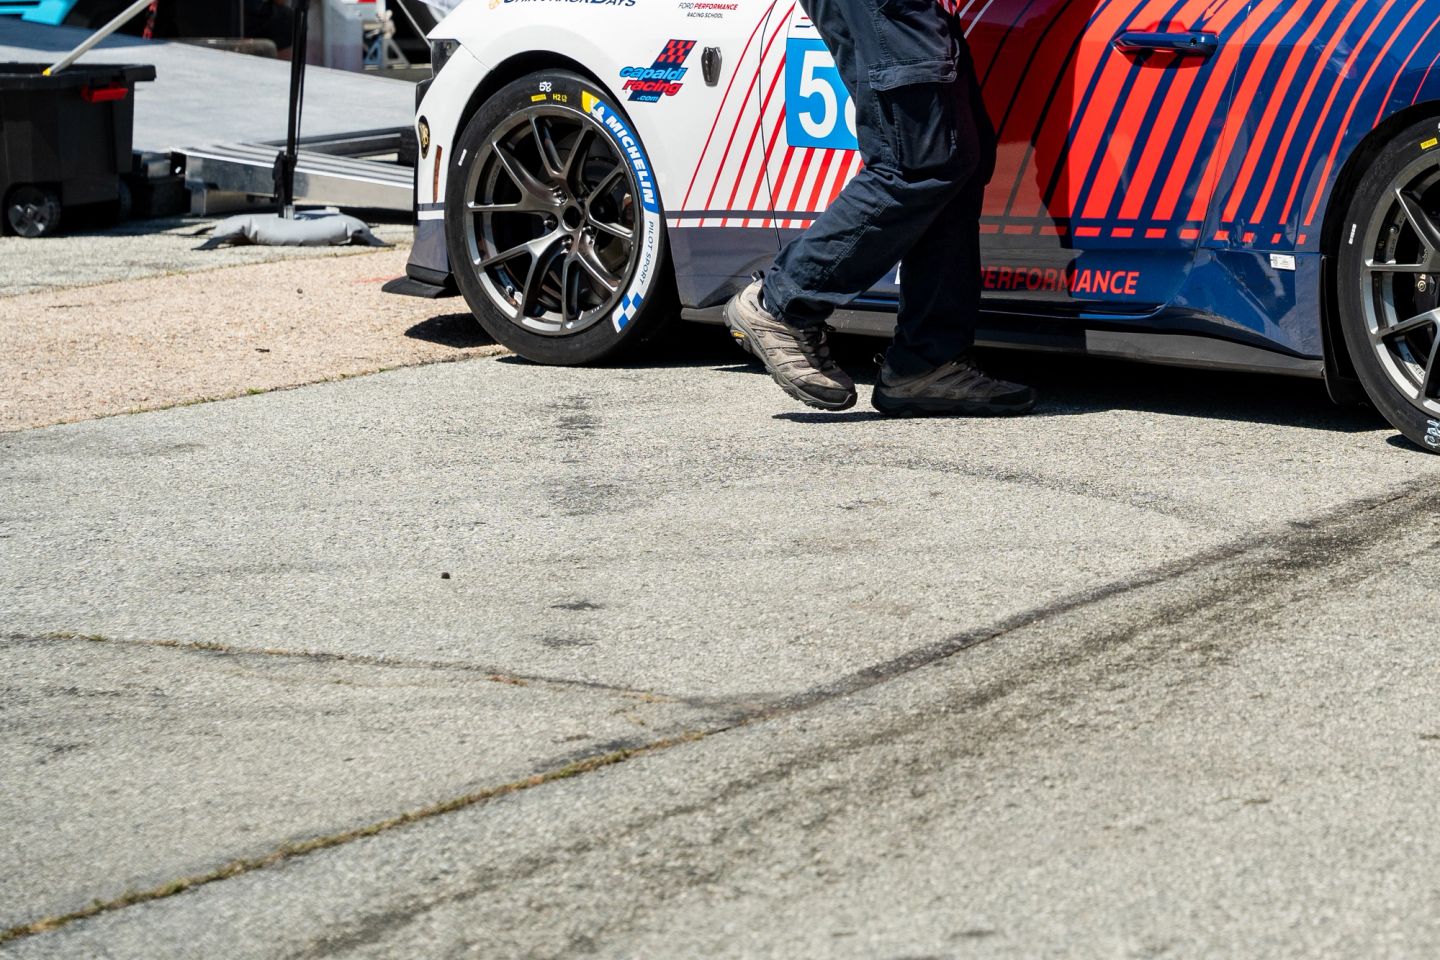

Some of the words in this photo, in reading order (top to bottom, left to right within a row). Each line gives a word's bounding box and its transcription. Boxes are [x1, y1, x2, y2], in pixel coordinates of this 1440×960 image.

[619, 66, 688, 81] capaldi
[622, 80, 683, 96] racing
[605, 115, 654, 205] MICHELIN
[640, 251, 652, 285] SPORT
